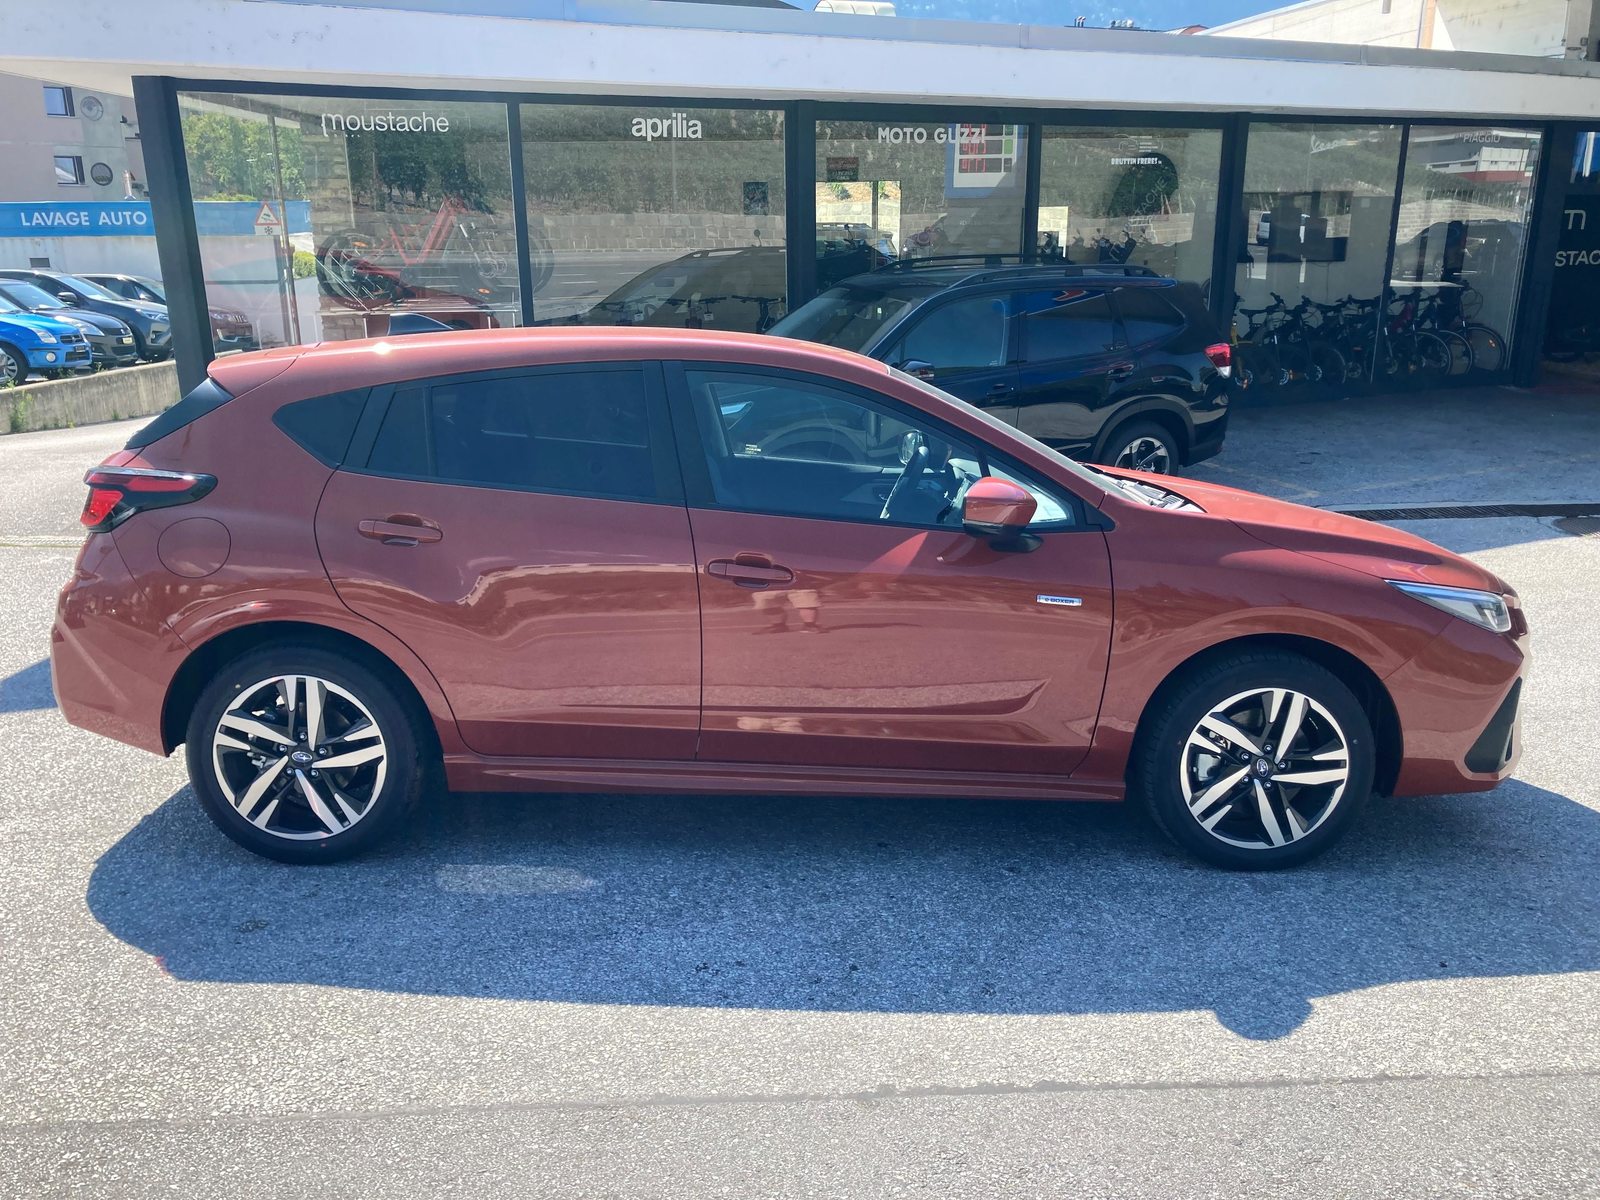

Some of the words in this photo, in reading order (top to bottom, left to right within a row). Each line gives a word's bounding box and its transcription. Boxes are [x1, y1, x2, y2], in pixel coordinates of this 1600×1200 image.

[321, 111, 450, 137] moustache
[631, 112, 702, 142] aprilia
[877, 127, 927, 144] MOTO
[933, 127, 986, 145] GUZZI
[20, 211, 90, 227] LAVAGE
[98, 210, 148, 226] AUTO
